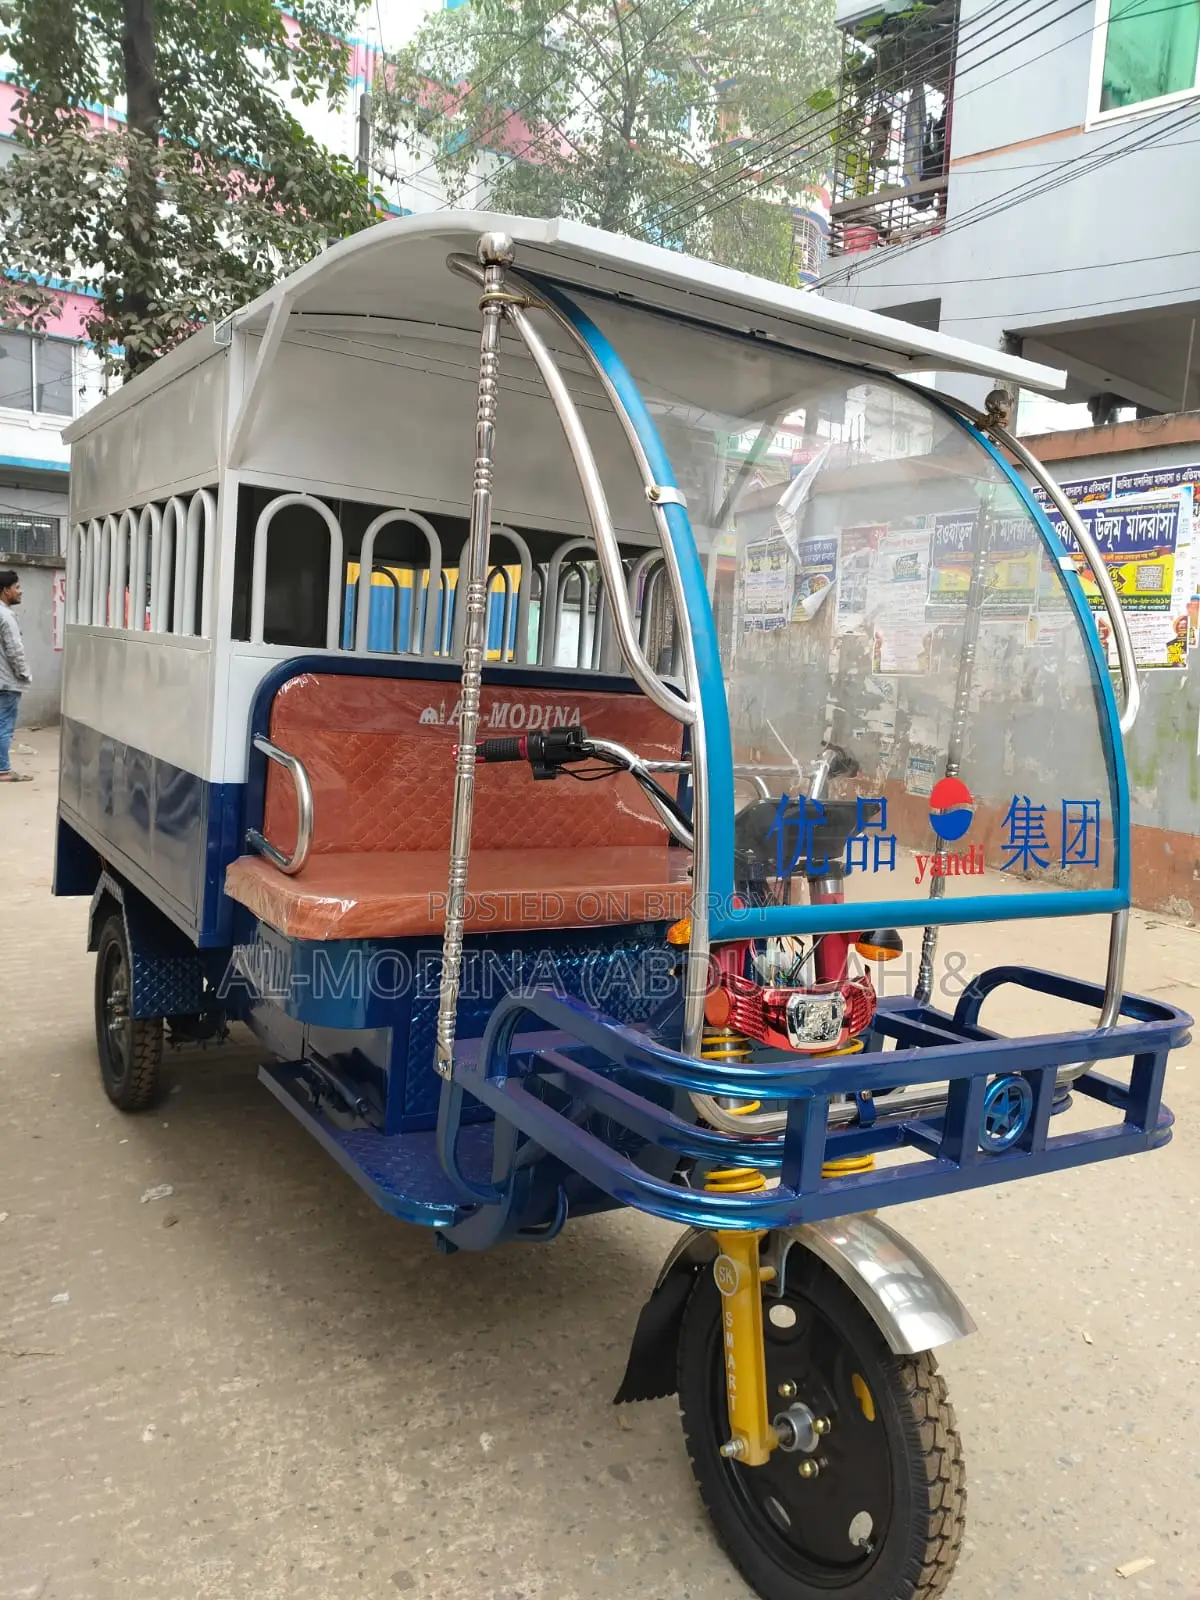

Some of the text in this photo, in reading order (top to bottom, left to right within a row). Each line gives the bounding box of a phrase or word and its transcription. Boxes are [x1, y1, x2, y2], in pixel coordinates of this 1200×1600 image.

[1126, 509, 1177, 542] মাদরাসা
[446, 699, 582, 730] A-MODINA
[766, 792, 1102, 878] 优品 集团
[914, 844, 984, 885] yandi
[719, 1266, 735, 1285] SK
[725, 1311, 738, 1412] SMART
